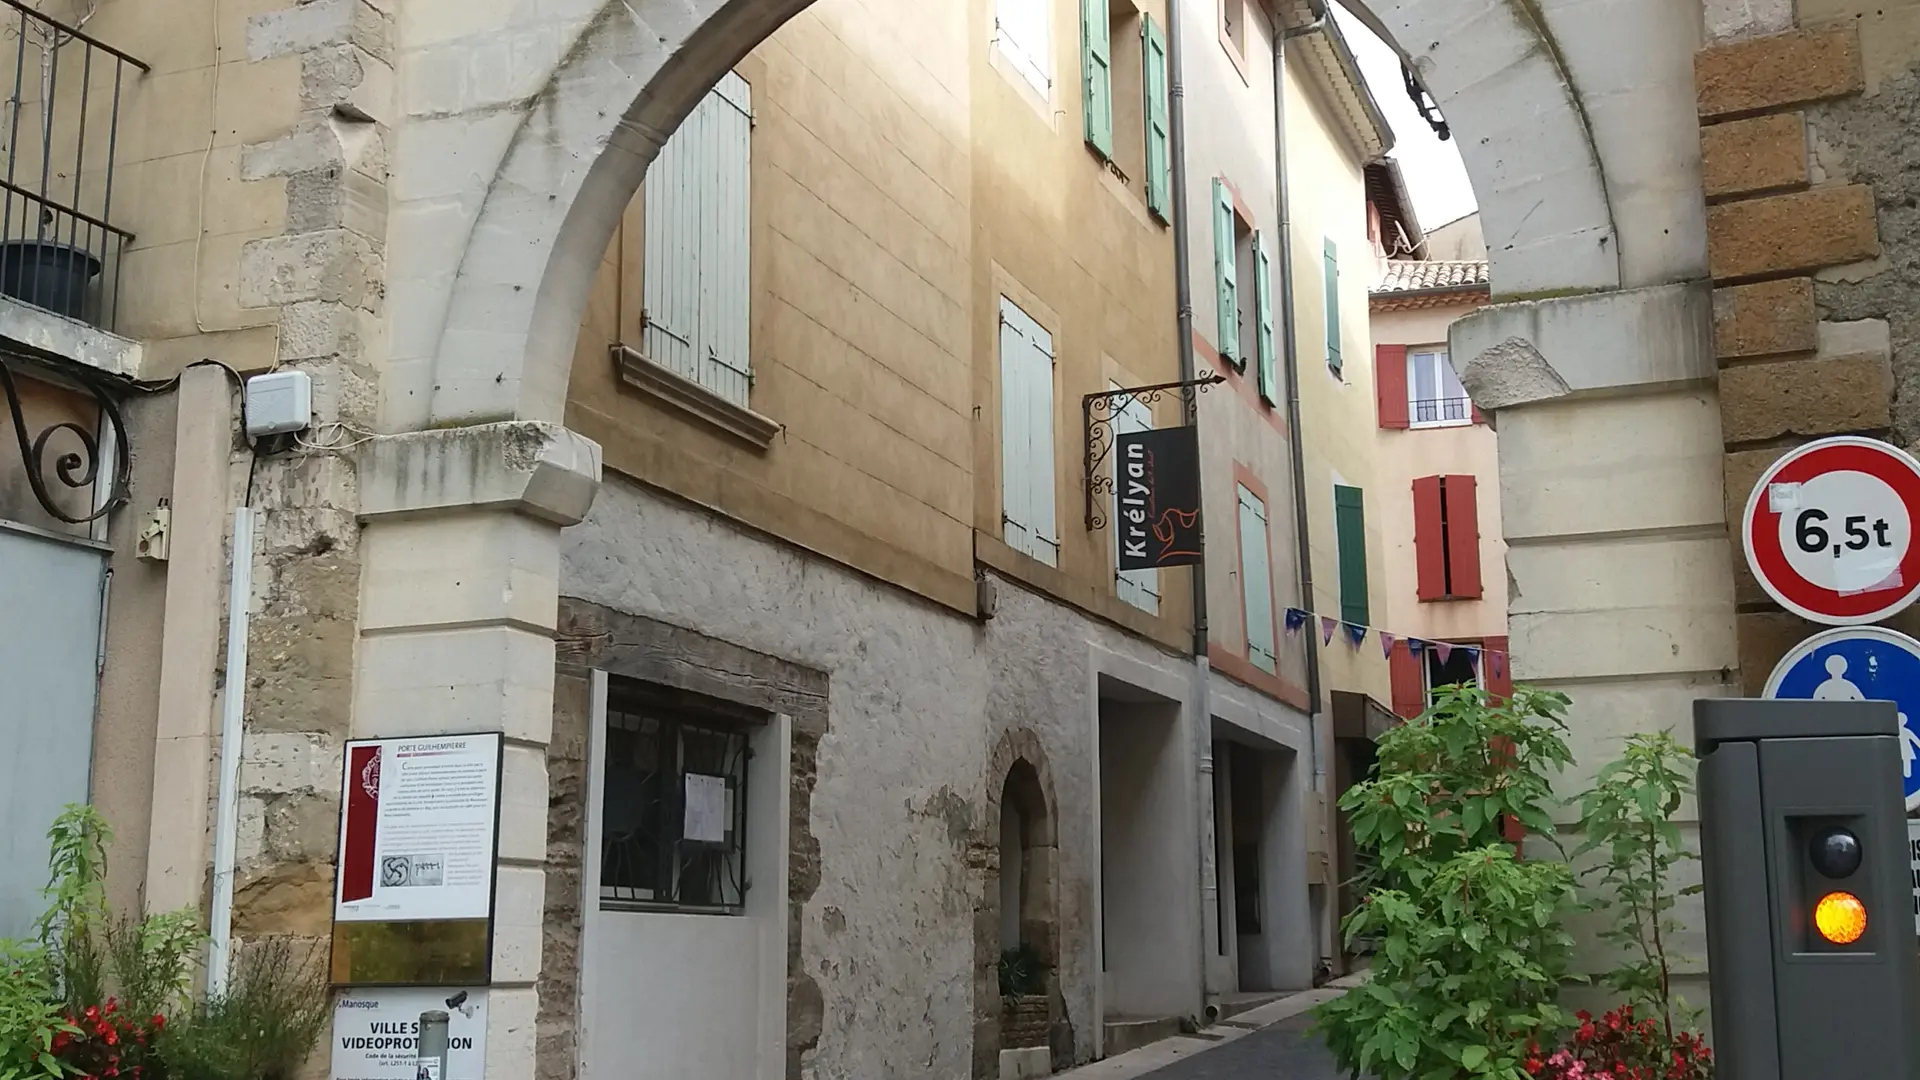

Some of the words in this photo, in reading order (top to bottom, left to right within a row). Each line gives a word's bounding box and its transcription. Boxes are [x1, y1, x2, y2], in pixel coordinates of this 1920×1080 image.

[1122, 442, 1151, 558] Krélyan
[397, 744, 417, 753] PORTE
[417, 741, 467, 752] GUILHEMPIERRE
[342, 999, 379, 1010] Manosque
[370, 1022, 407, 1034] VILLE
